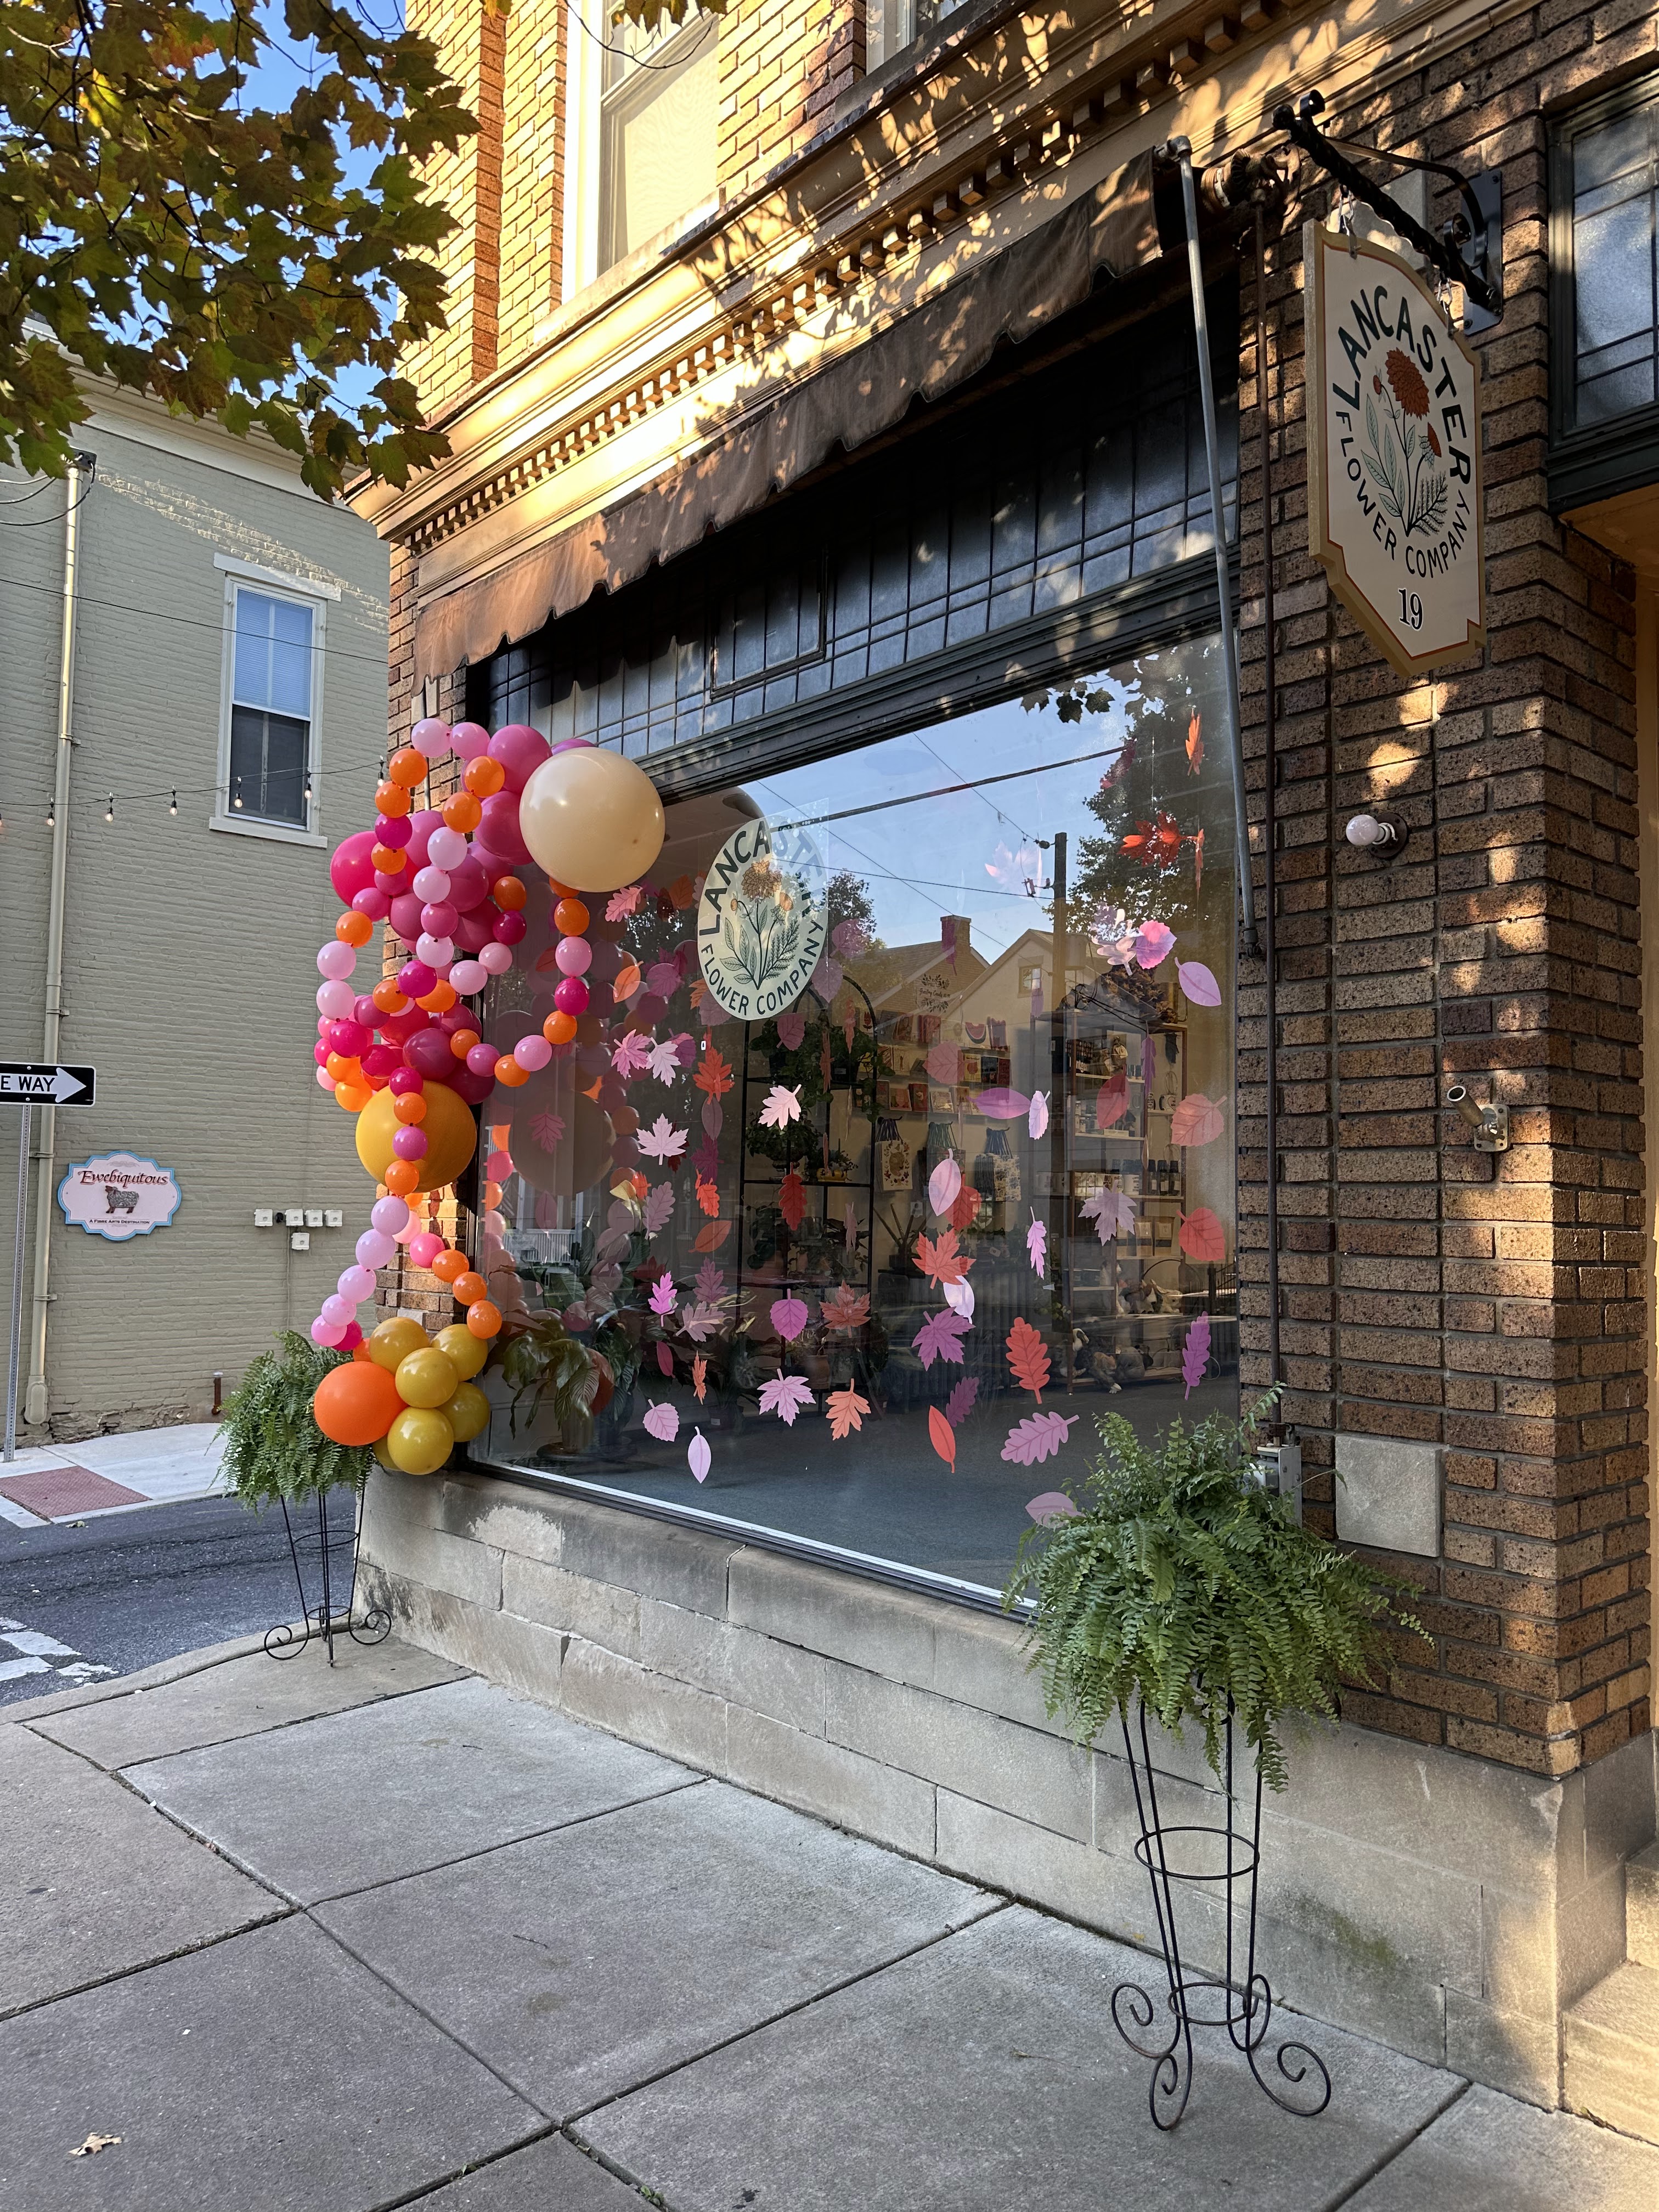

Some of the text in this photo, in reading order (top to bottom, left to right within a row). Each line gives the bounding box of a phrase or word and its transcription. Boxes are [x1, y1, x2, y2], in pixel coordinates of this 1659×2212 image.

[1333, 285, 1471, 485] LANCASTER
[1336, 411, 1470, 578] FLOWER COMPANY
[1398, 589, 1423, 630] 19
[701, 920, 823, 1015] FLOWER COMPANY
[19, 1076, 55, 1092] WAY
[78, 1169, 168, 1188] Ewebiquitous
